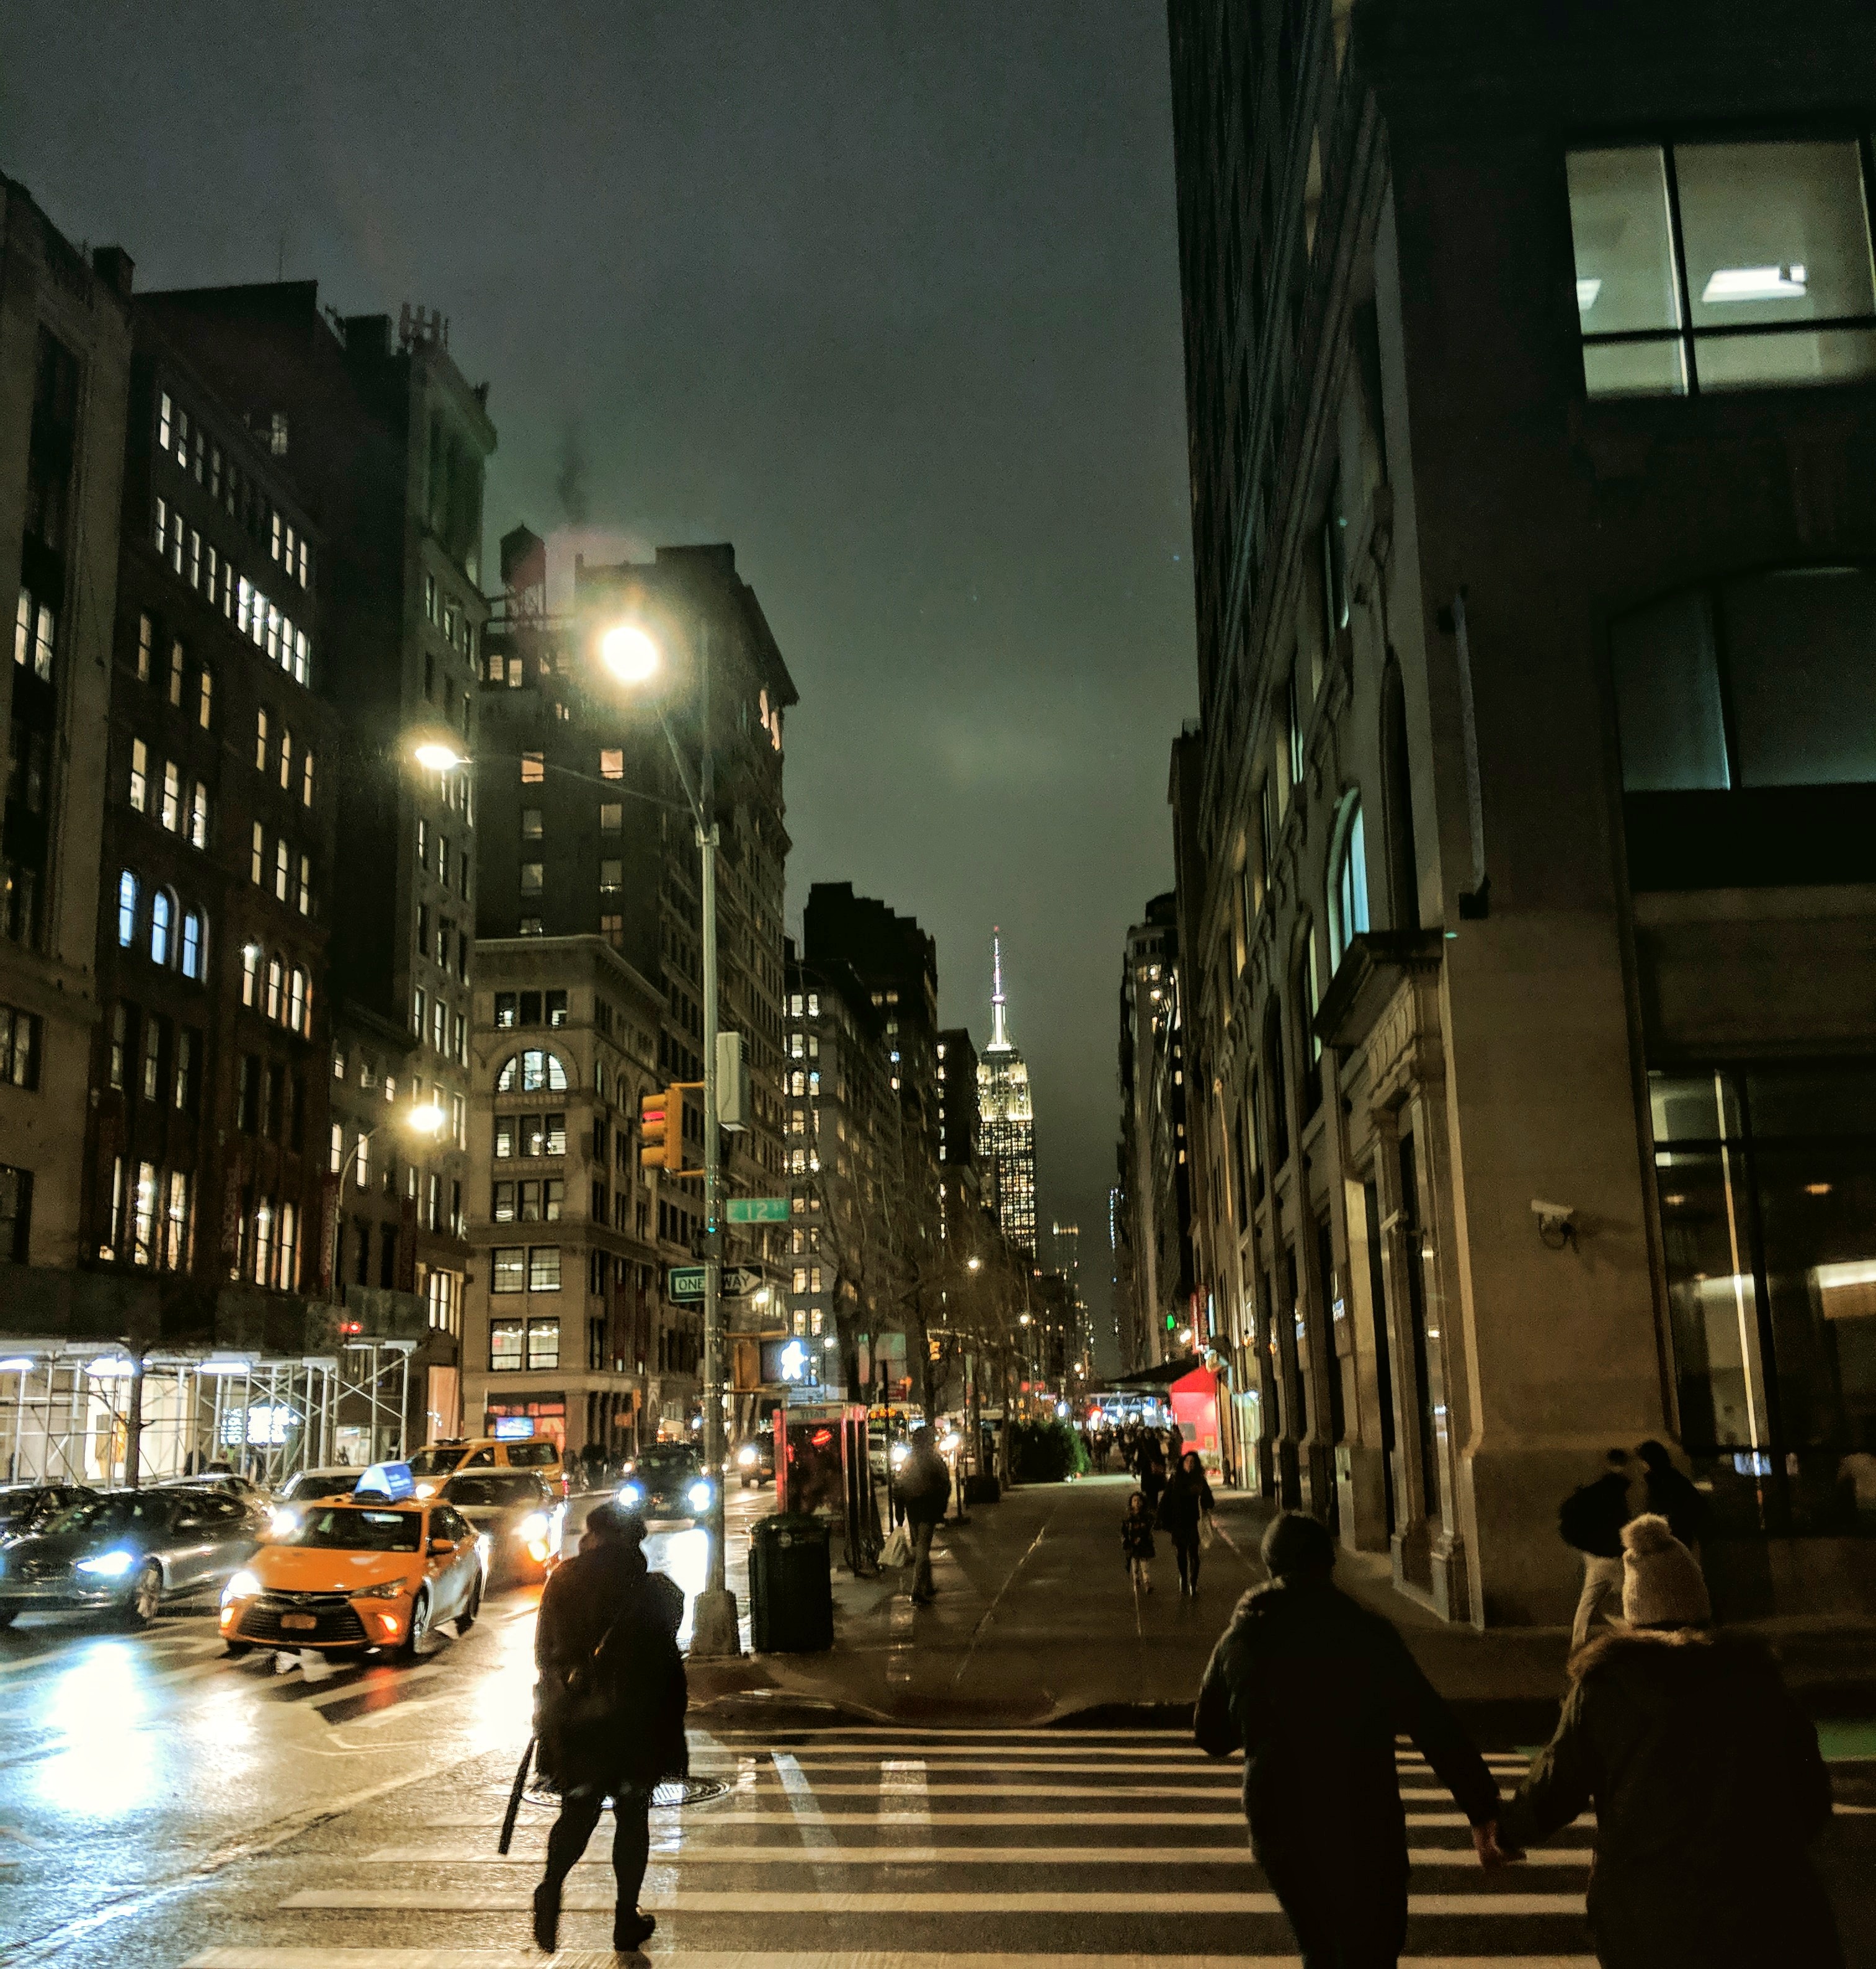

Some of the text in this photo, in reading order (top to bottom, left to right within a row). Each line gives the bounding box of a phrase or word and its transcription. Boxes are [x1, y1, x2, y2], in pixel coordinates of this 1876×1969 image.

[747, 1202, 767, 1221] 12
[679, 1273, 750, 1290] ONE WAY
